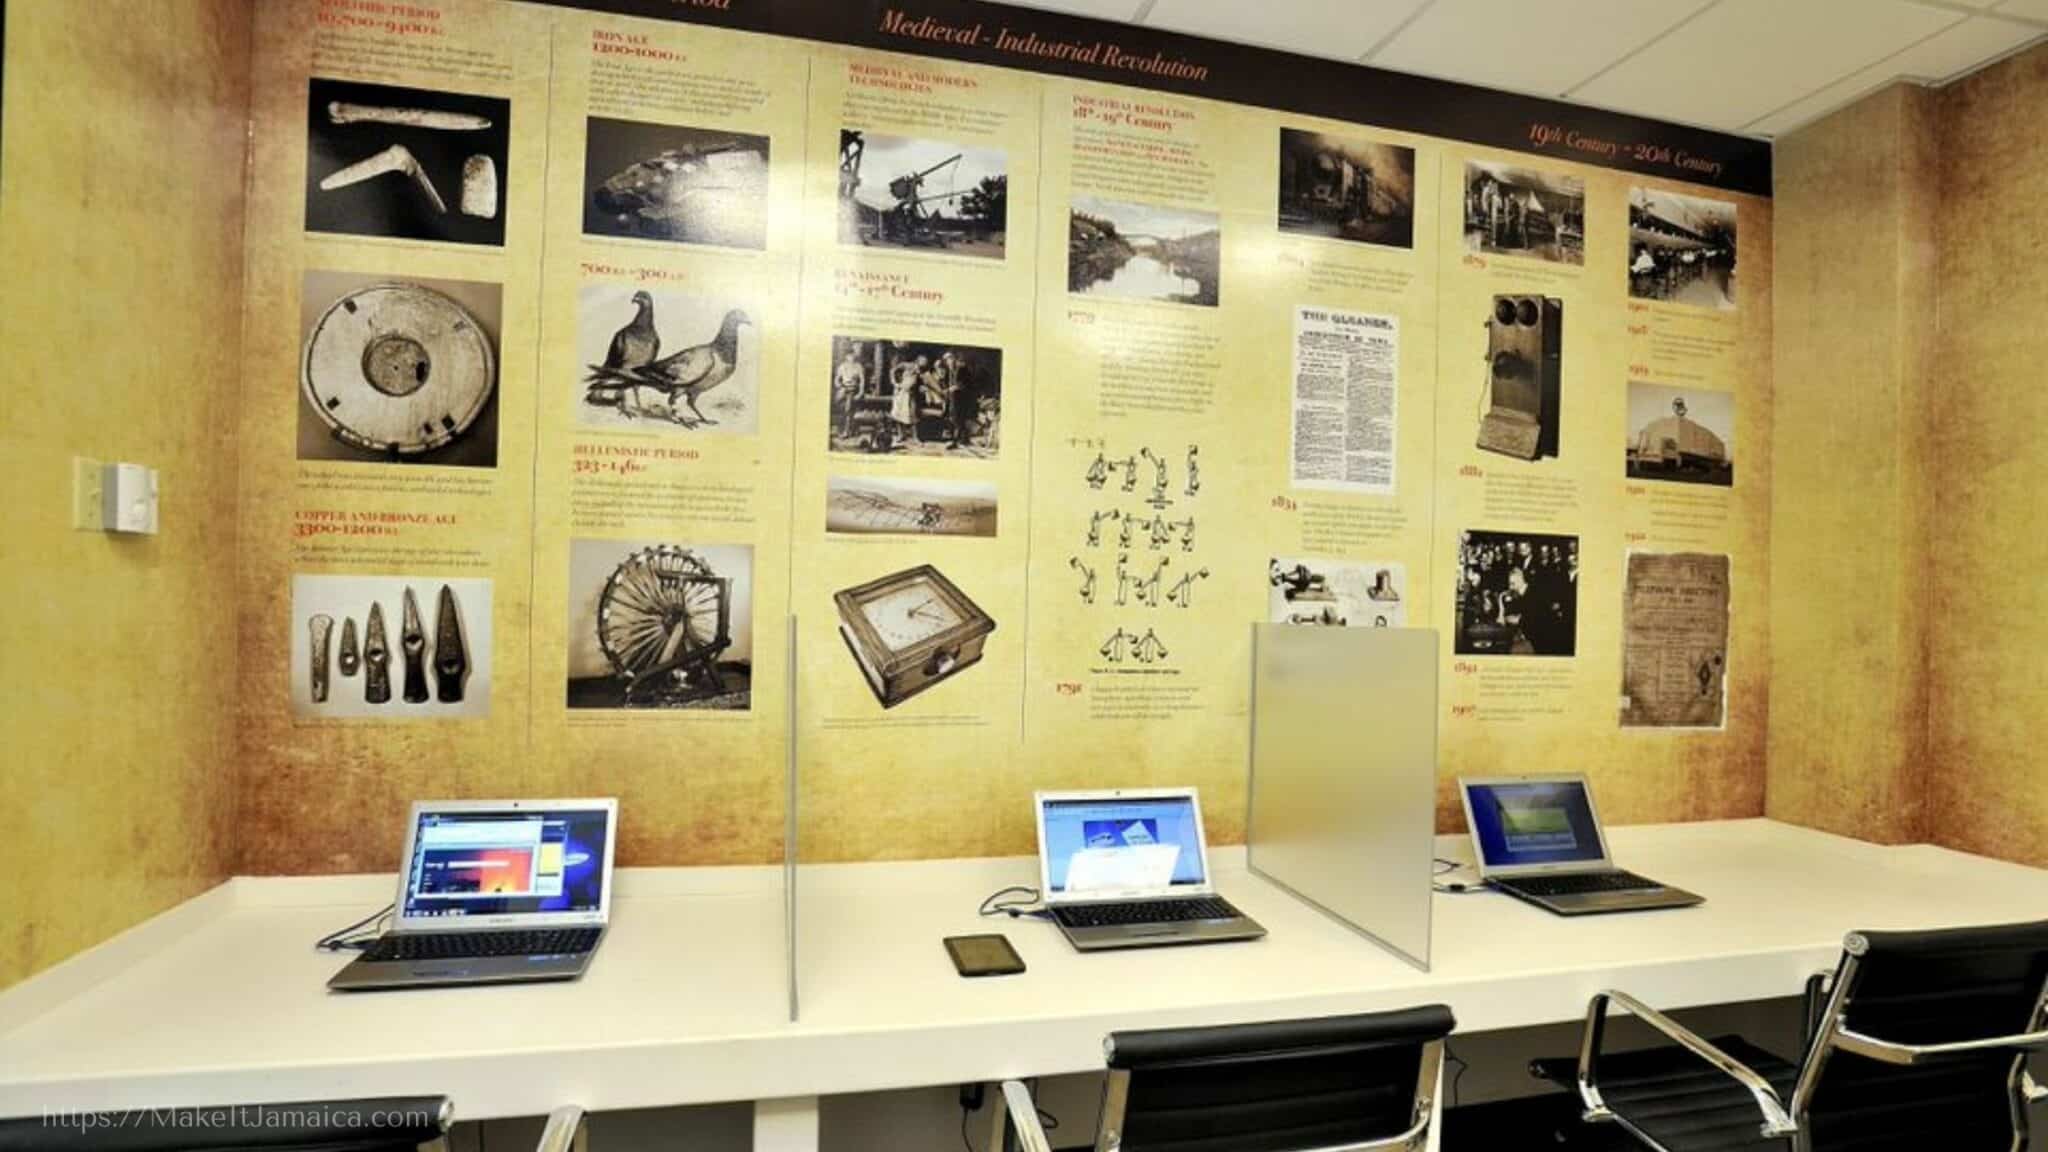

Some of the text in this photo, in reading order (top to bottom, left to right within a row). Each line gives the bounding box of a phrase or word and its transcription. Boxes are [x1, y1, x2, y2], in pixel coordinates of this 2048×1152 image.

[592, 30, 622, 43] IRON
[880, 10, 982, 46] Medieval
[995, 28, 1100, 64] Industrial
[1101, 45, 1209, 81] Revolution
[1125, 113, 1173, 132] Century
[1528, 123, 1562, 147] 19th
[1565, 129, 1618, 160] Century
[1633, 143, 1671, 163] 20th
[1673, 151, 1723, 177] Century
[891, 284, 943, 305] Century
[294, 510, 347, 522] COPPER
